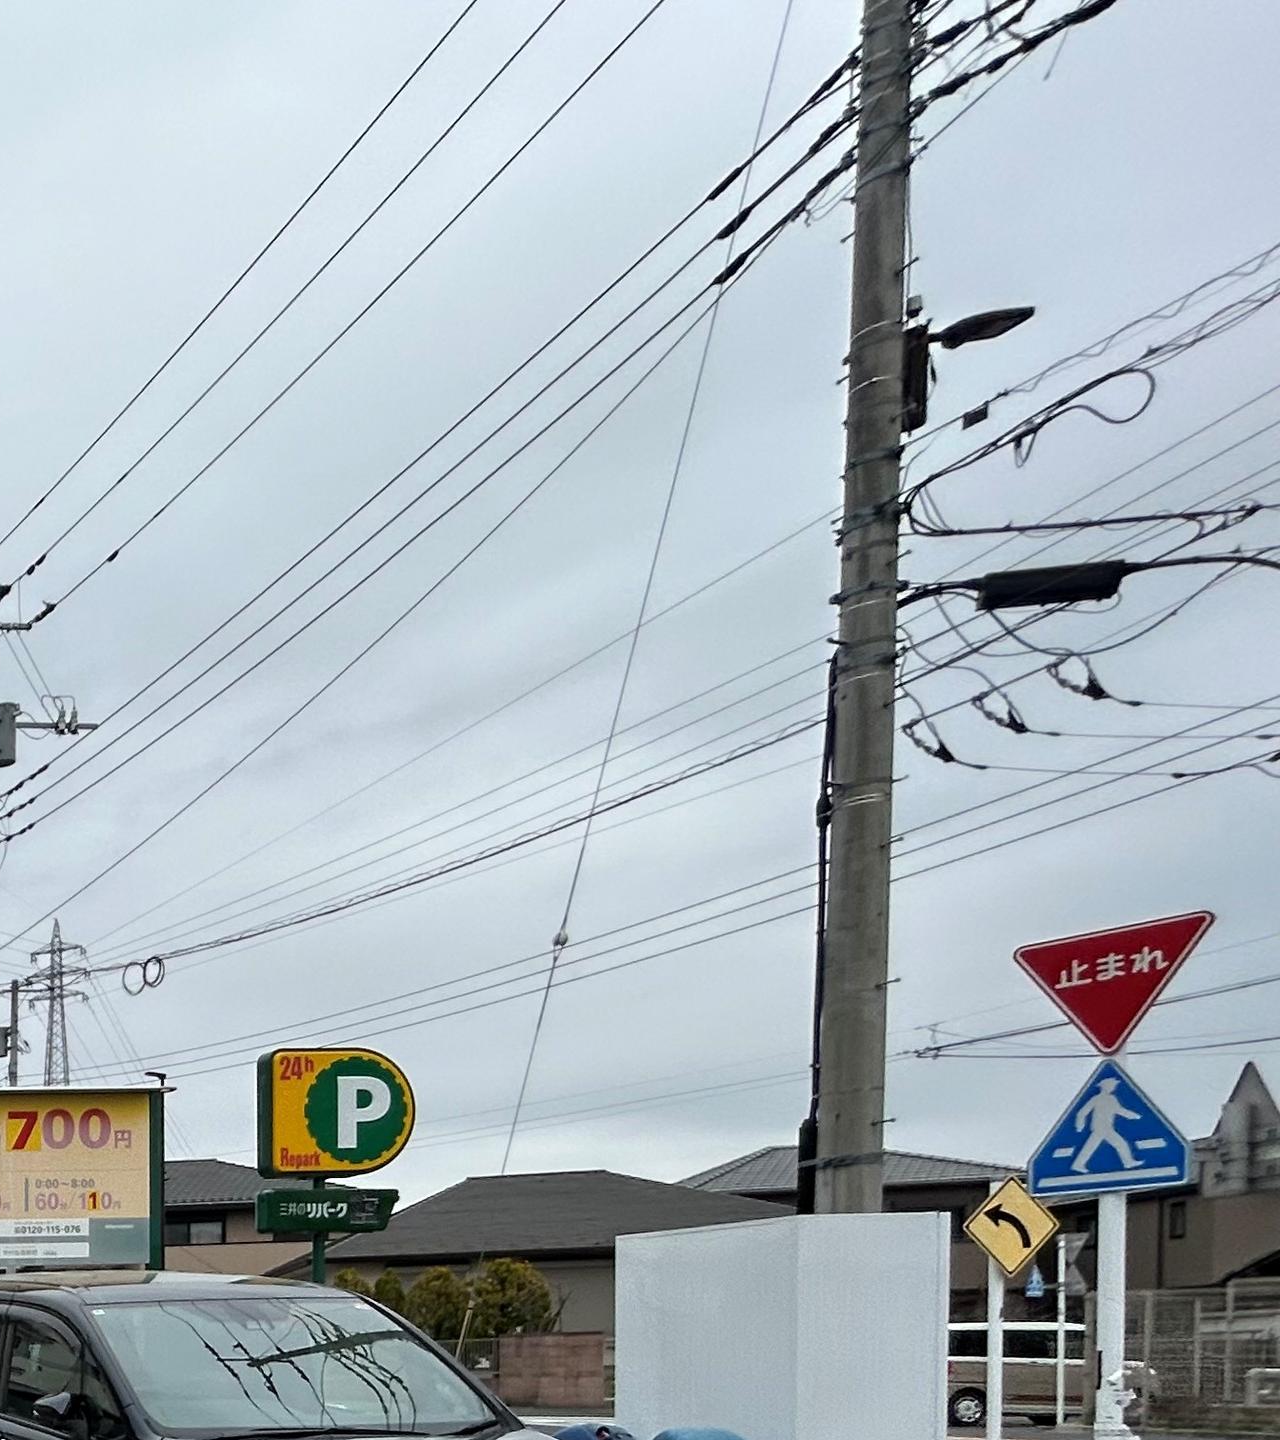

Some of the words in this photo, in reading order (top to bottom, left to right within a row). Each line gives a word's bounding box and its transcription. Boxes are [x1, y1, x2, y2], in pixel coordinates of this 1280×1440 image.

[1054, 946, 1169, 990] 止まれ
[280, 1056, 314, 1080] 24h
[337, 1075, 391, 1149] P
[279, 1200, 348, 1218] 三井のリパーク
